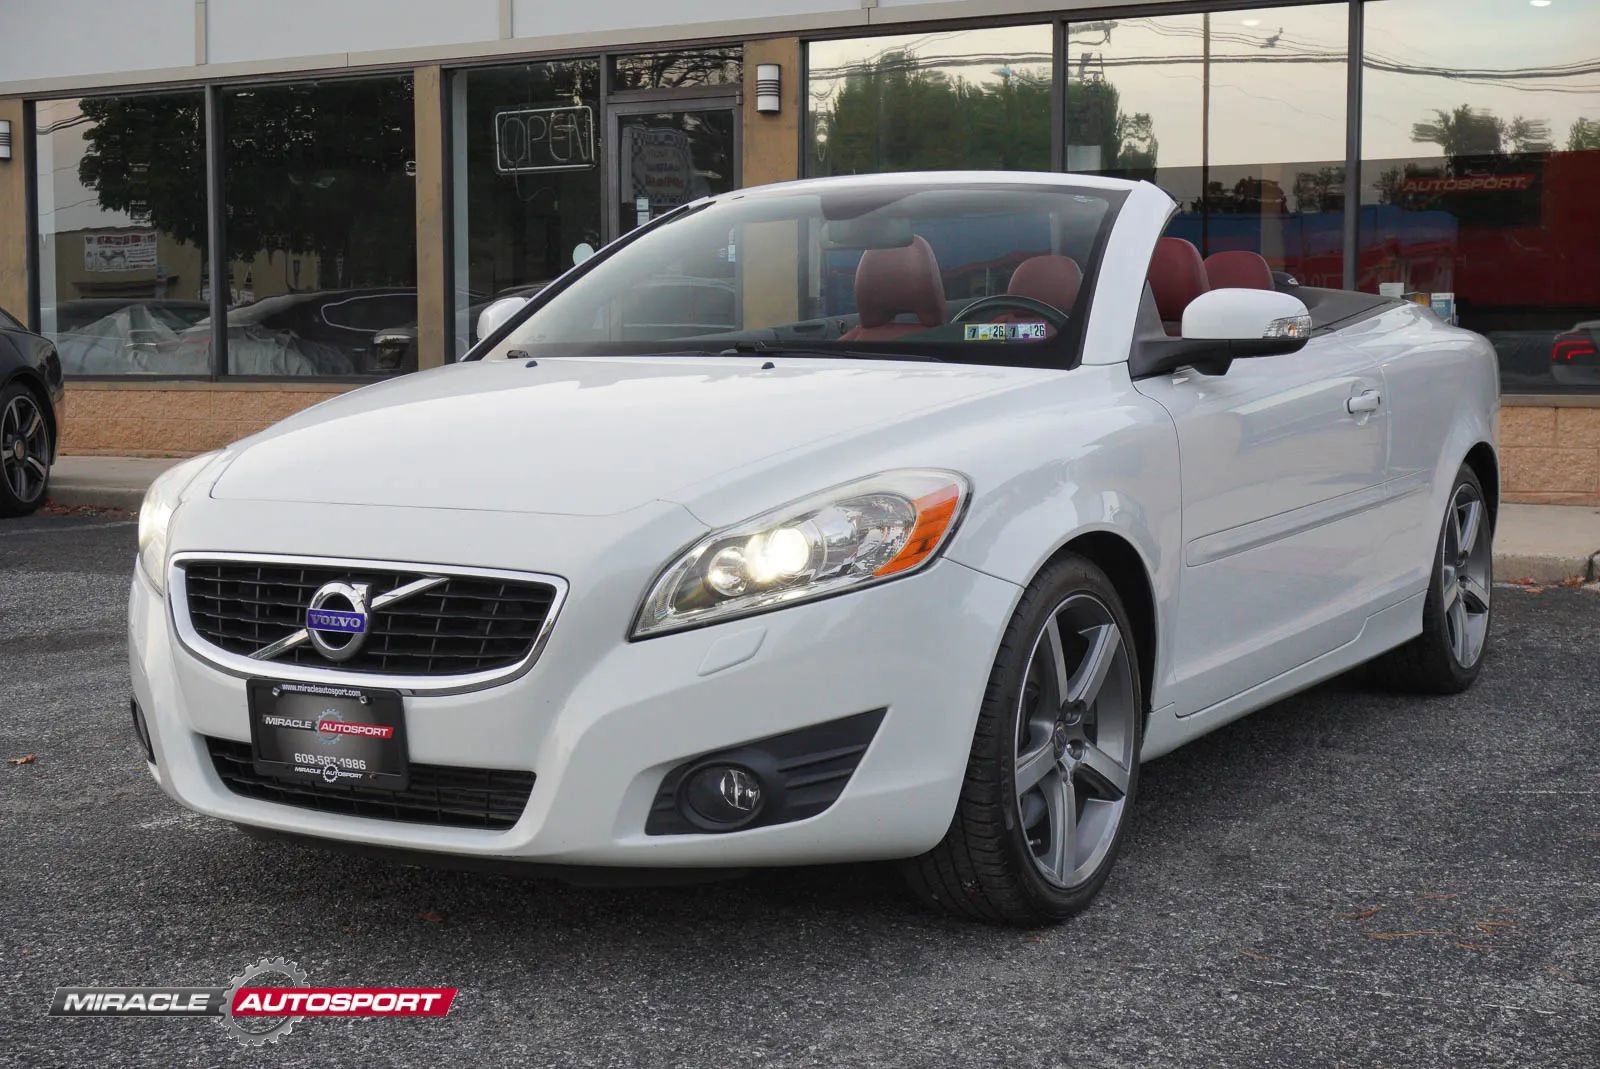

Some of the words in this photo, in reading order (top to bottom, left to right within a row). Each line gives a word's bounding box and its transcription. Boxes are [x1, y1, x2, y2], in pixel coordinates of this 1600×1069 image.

[501, 113, 589, 164] OPEN
[970, 328, 976, 338] 7
[993, 325, 1004, 338] 26
[1010, 327, 1016, 337] 7
[1034, 324, 1045, 337] 26
[309, 613, 362, 629] VOLVO
[282, 683, 362, 697] www.miracleautosport.com
[265, 716, 312, 729] MIRACLE
[320, 722, 389, 737] AUTOSPORT
[294, 766, 322, 775] MIRACLE
[325, 769, 363, 780] AUTOSPORT
